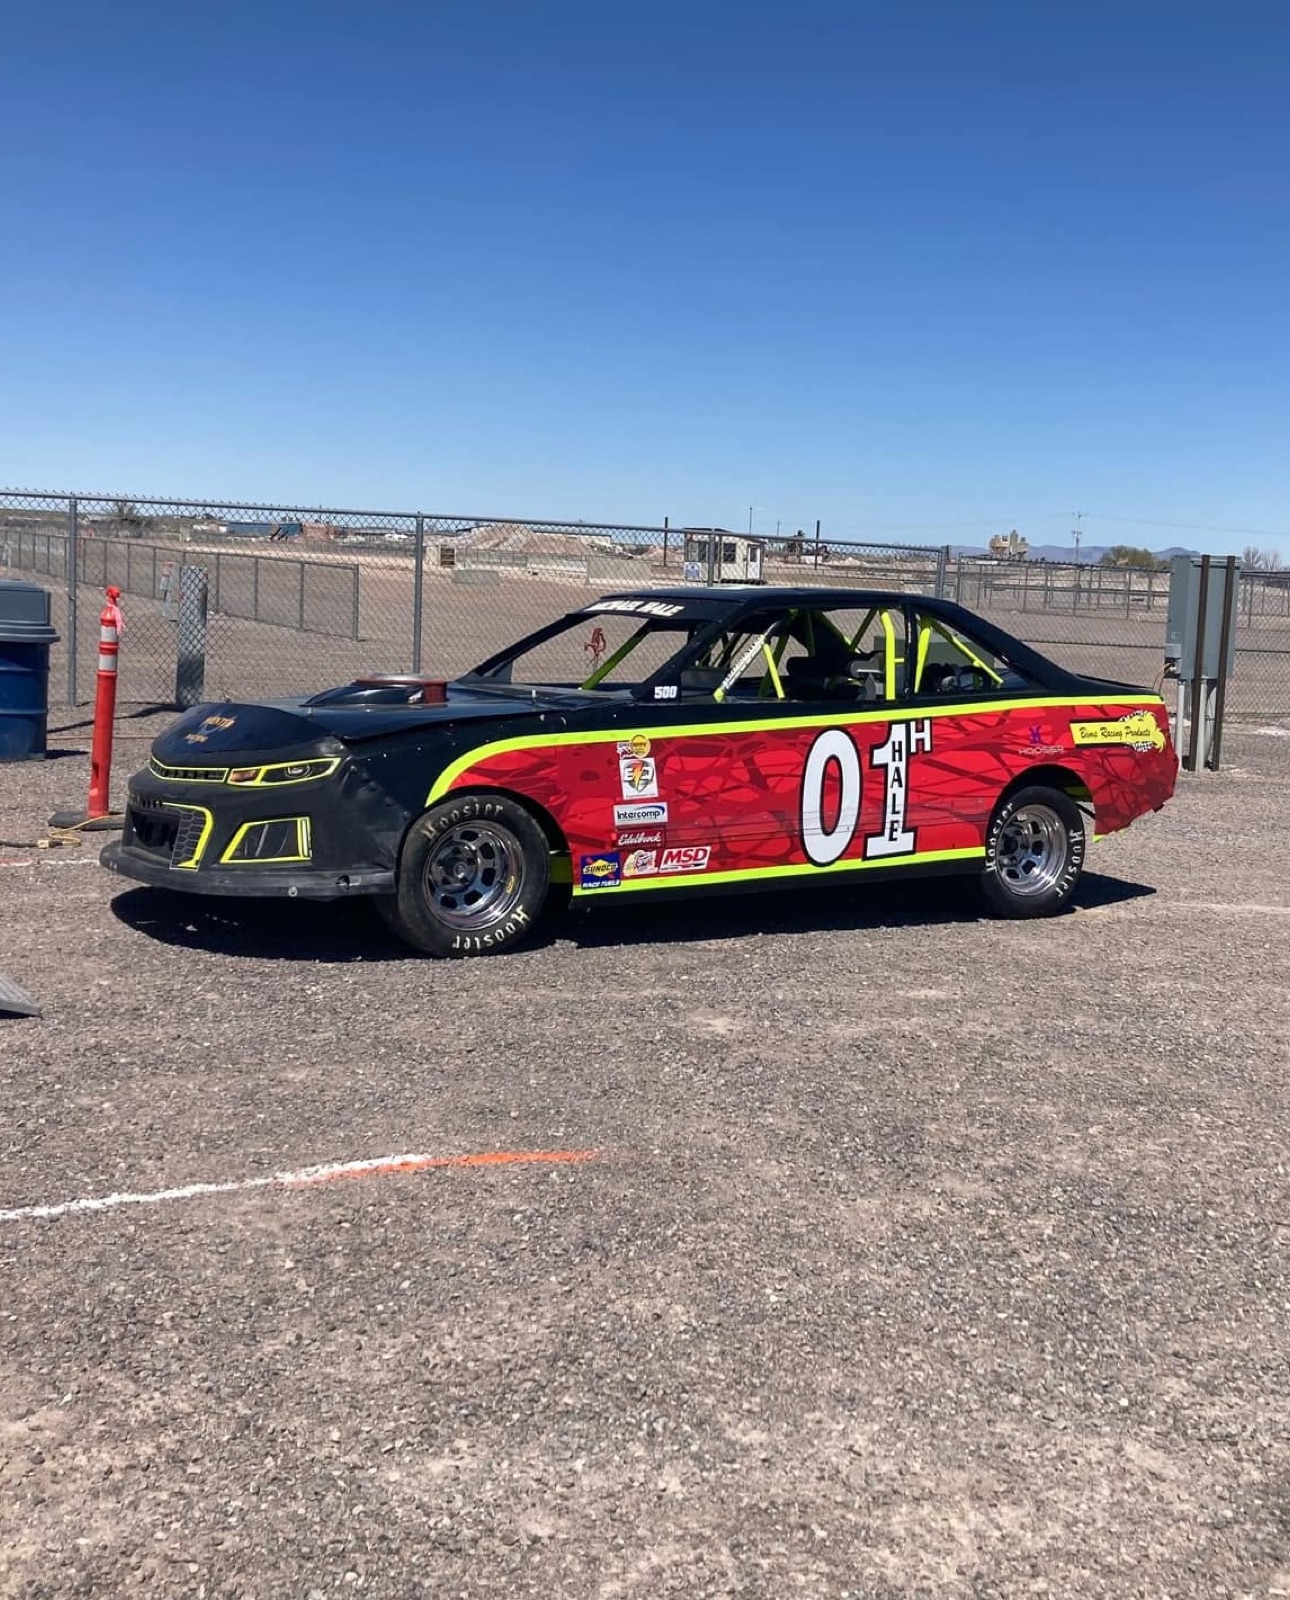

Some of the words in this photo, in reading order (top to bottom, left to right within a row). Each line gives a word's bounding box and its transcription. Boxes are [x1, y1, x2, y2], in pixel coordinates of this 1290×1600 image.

[654, 686, 678, 699] 500
[909, 717, 932, 754] H
[1124, 726, 1151, 738] Products
[800, 723, 917, 866] 01
[889, 740, 903, 842] HALE
[617, 810, 661, 820] Intercomp
[618, 831, 662, 846] Edelbrock
[986, 802, 1013, 872] Hoosier
[584, 864, 617, 875] SUNOCO
[663, 848, 708, 865] MSD
[1055, 829, 1083, 898] Hoosier
[452, 904, 532, 950] Hoosier
